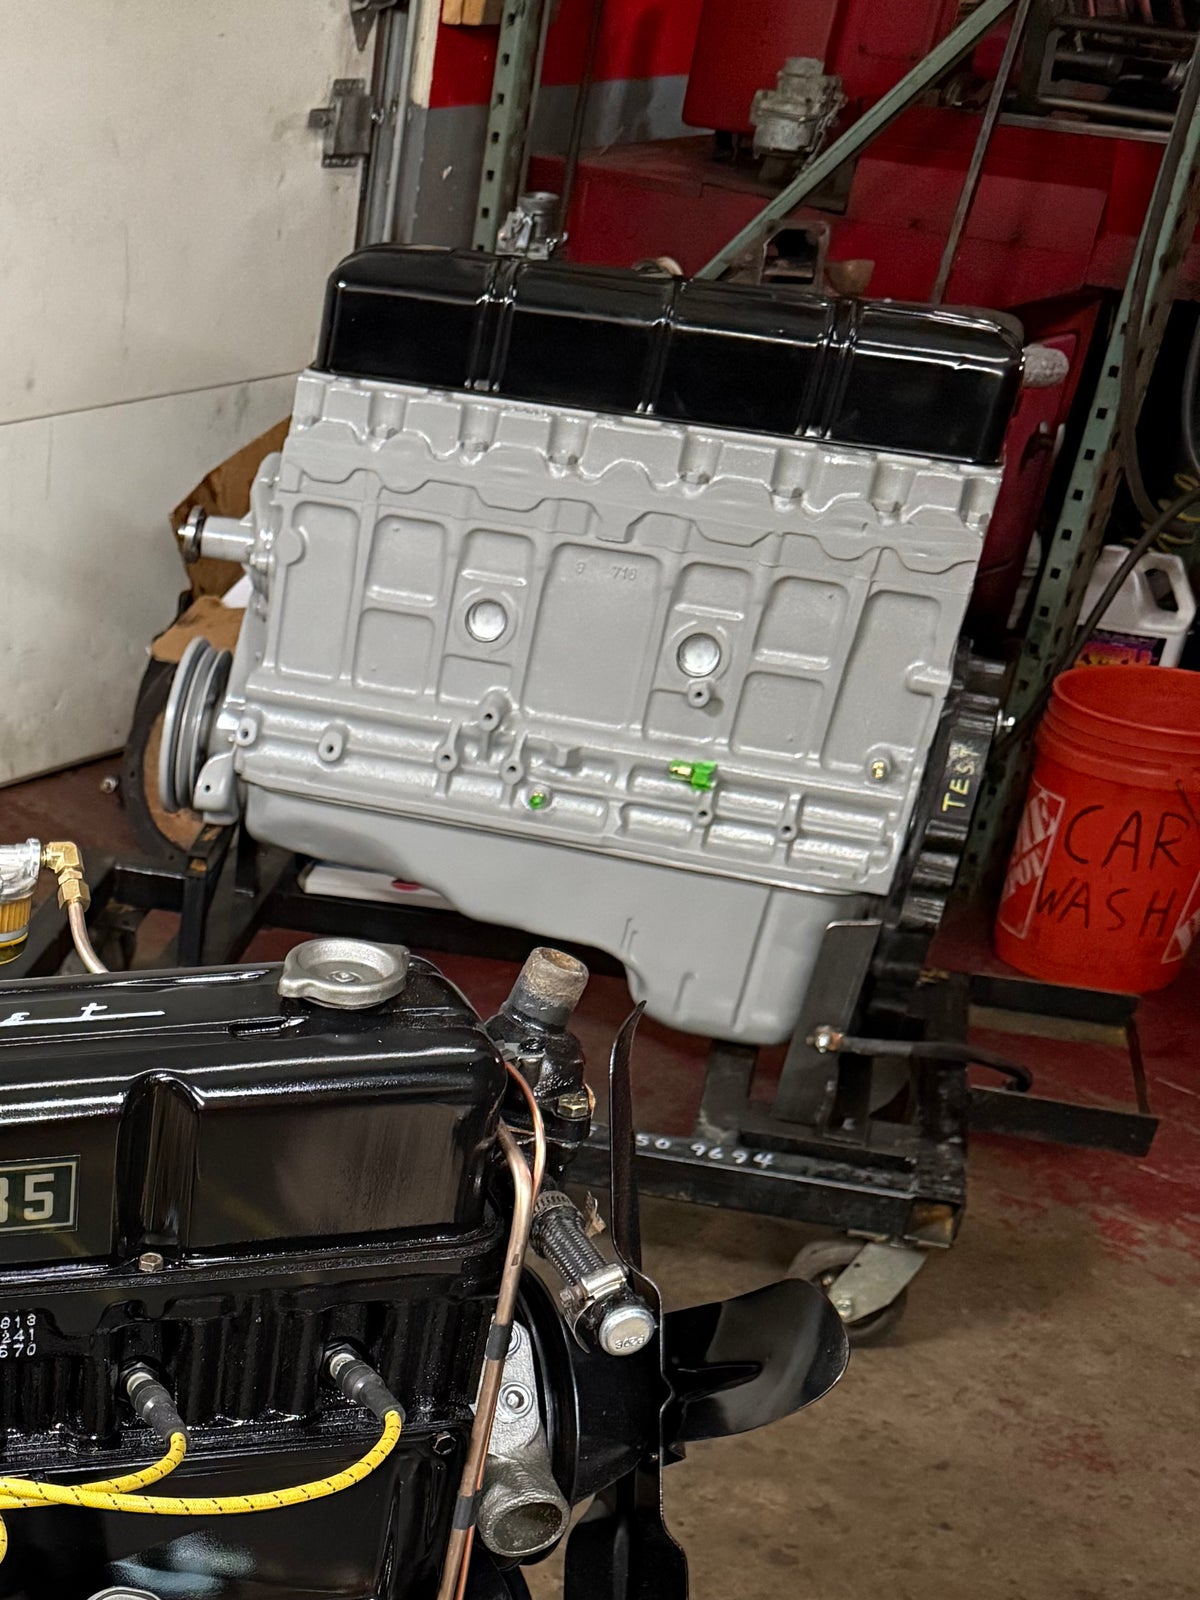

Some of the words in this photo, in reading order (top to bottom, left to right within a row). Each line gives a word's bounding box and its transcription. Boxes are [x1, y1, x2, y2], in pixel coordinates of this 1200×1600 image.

[942, 742, 981, 812] TEST
[1064, 804, 1190, 872] CAR
[1036, 866, 1176, 938] WASH
[1, 1328, 35, 1343] 241
